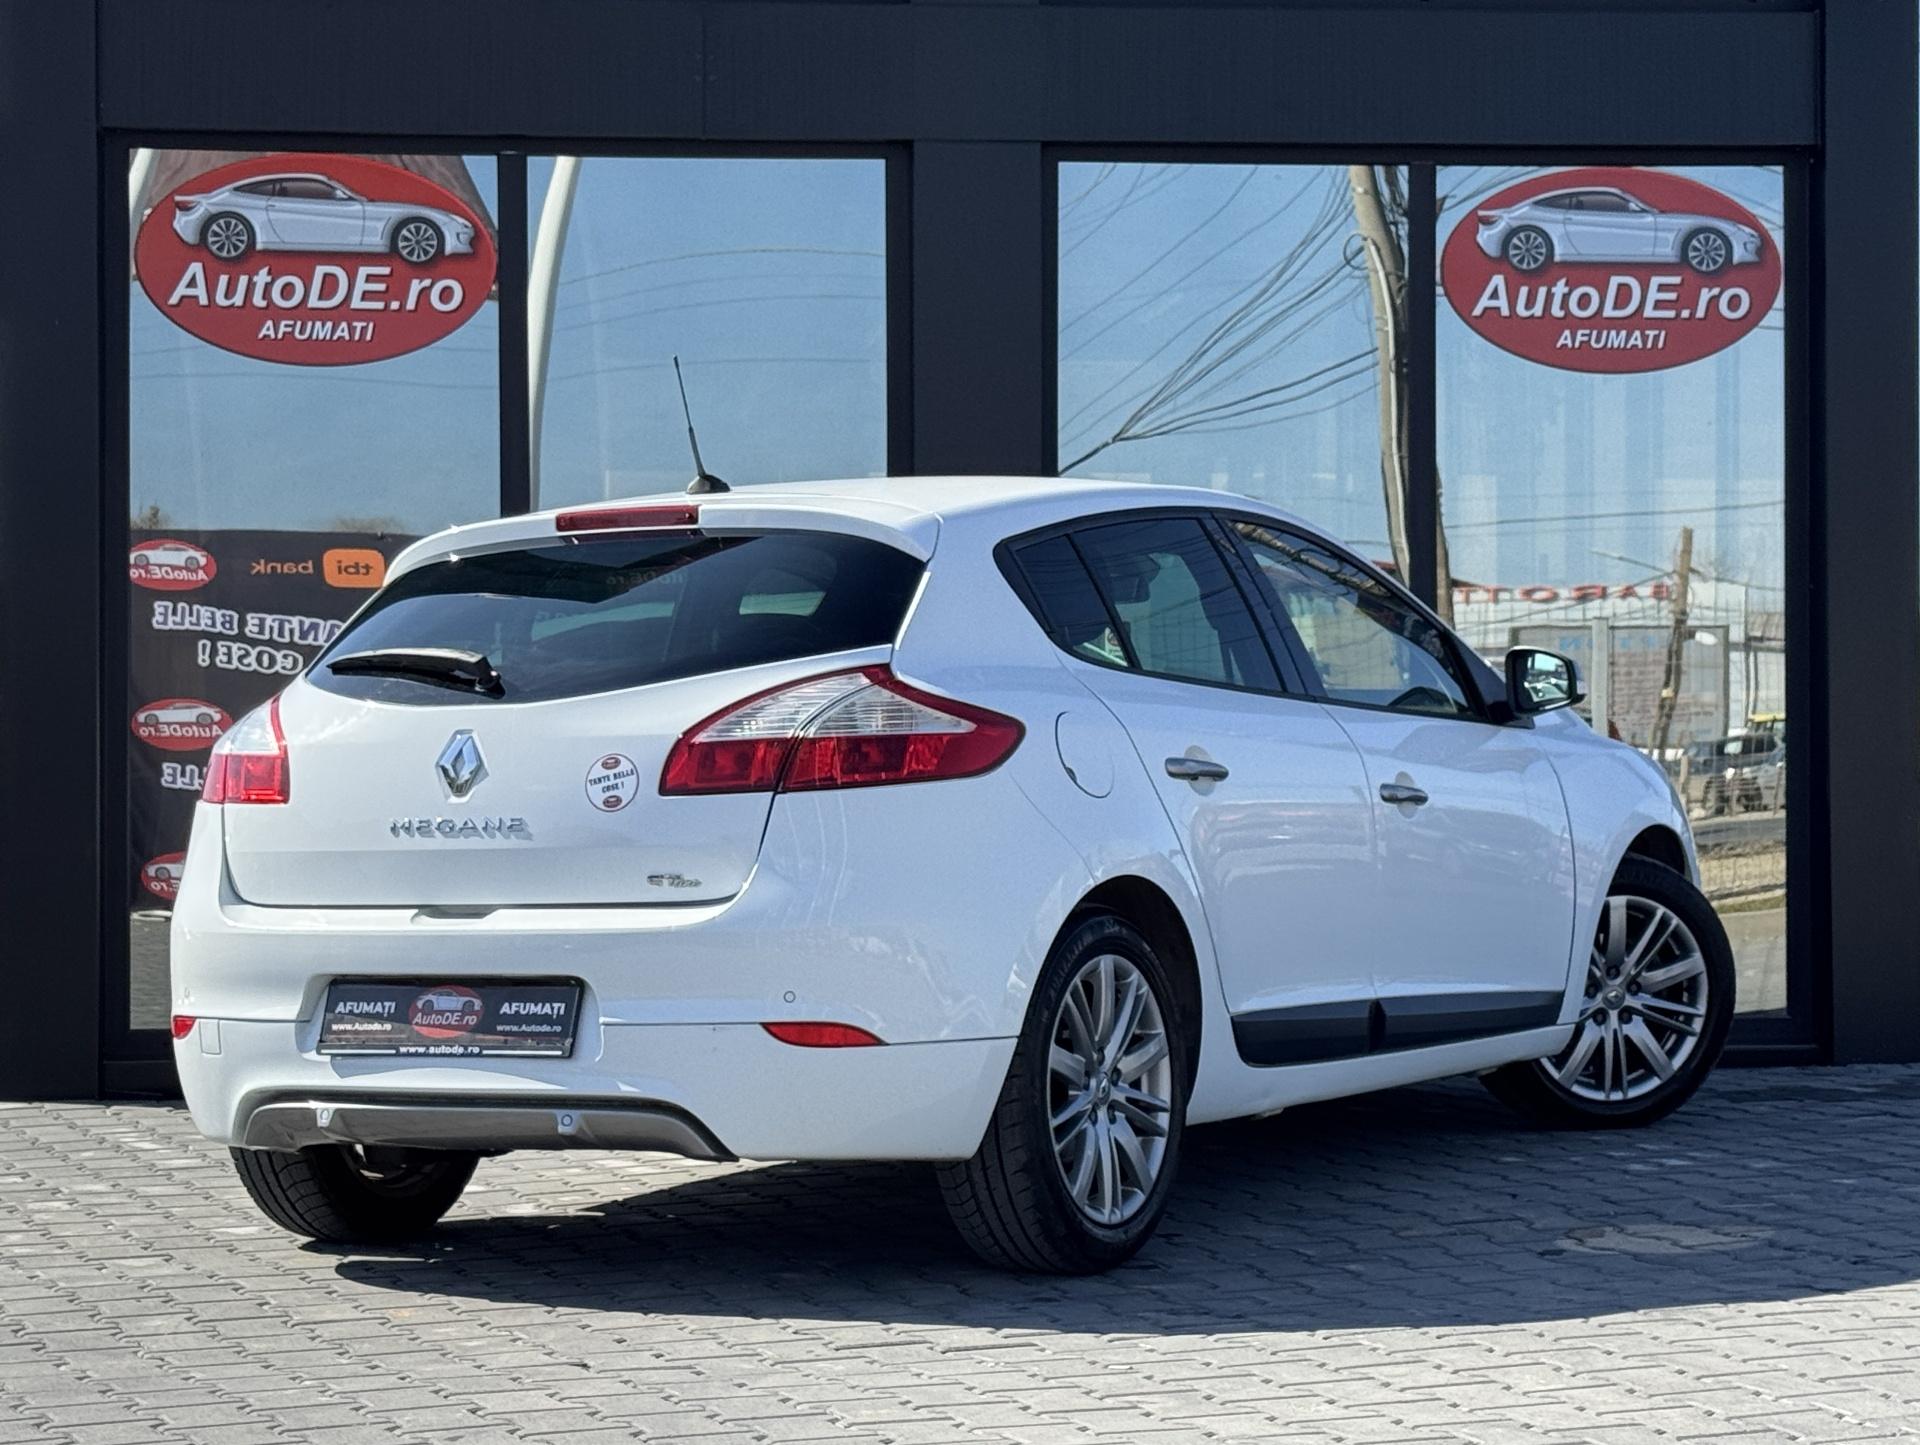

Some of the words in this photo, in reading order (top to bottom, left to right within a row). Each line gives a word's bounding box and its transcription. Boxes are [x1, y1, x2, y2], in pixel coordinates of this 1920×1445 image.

[167, 262, 465, 312] AutoDE.ro
[1472, 274, 1751, 320] AutoDE.ro
[257, 319, 375, 341] AFUMATI
[1556, 329, 1667, 350] AFUMATI
[389, 816, 528, 837] MEGANE
[412, 1011, 479, 1026] AutoDE.ro
[496, 1024, 562, 1033] www.Autode.ro
